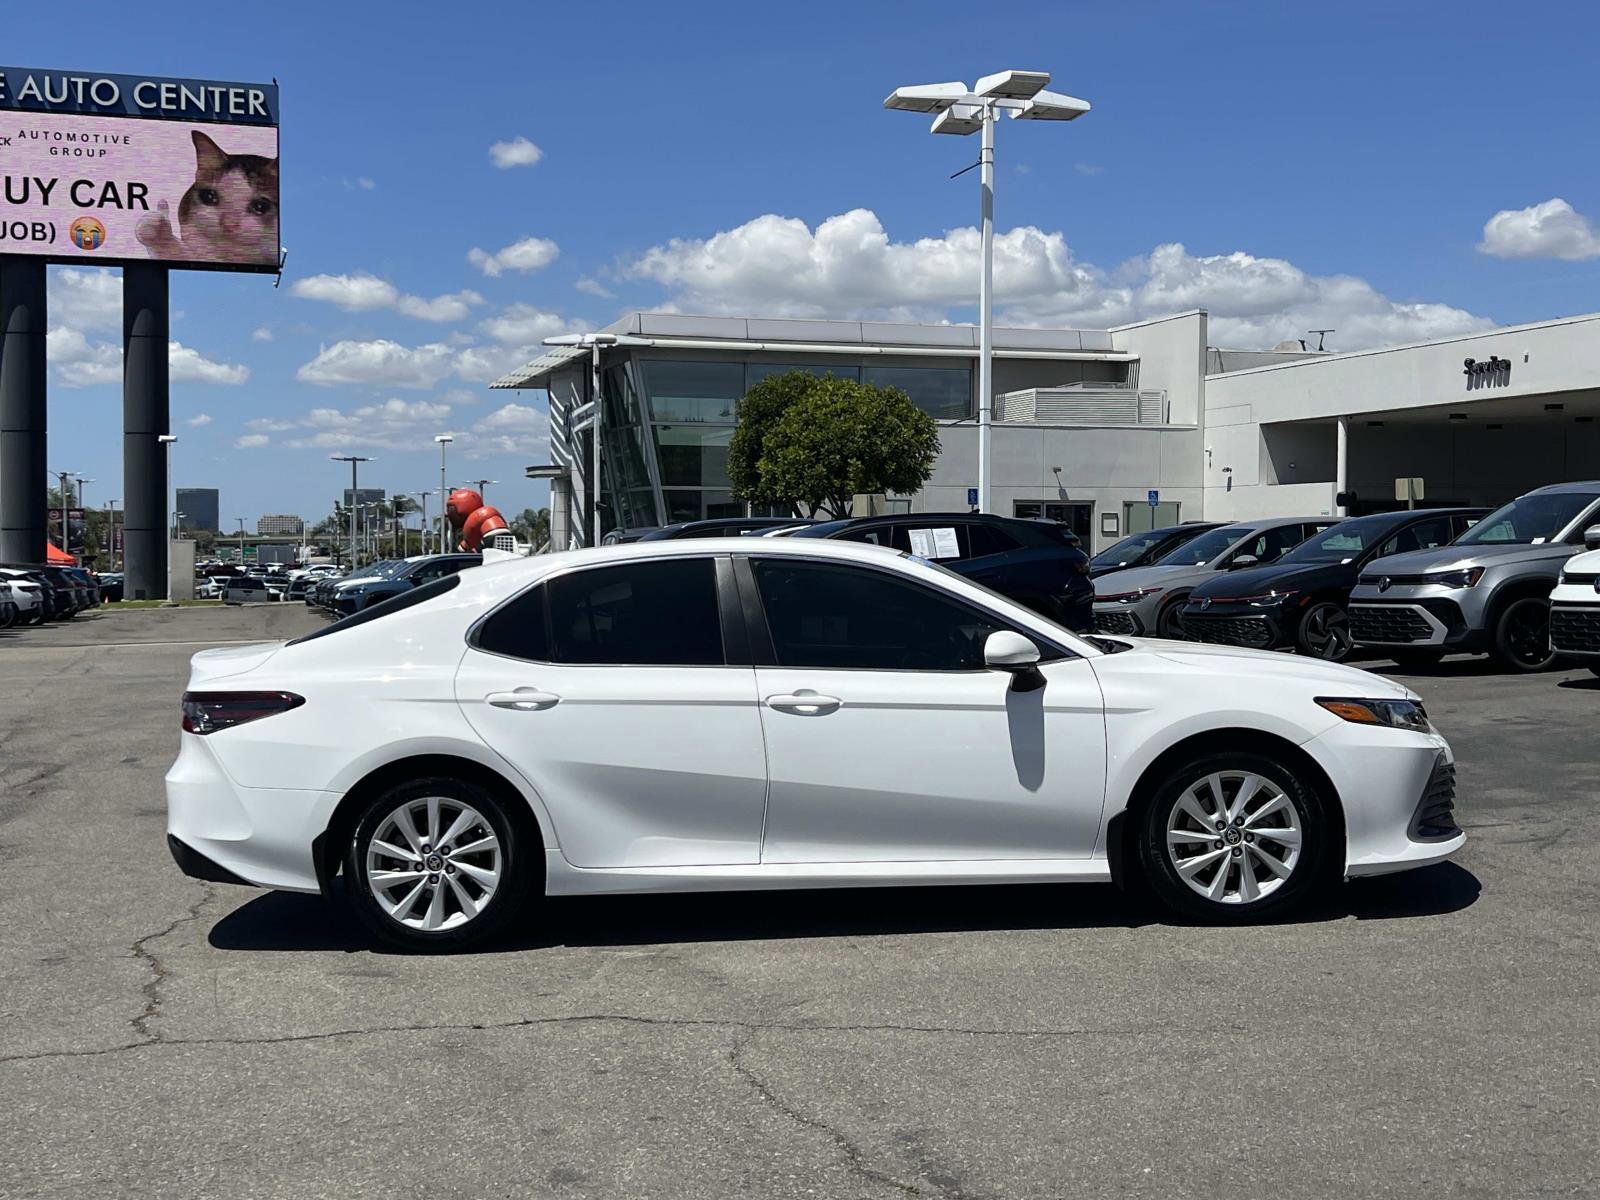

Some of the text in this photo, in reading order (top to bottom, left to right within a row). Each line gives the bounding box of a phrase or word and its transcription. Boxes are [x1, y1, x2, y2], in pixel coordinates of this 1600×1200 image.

[18, 75, 120, 106] AUTO
[134, 81, 267, 116] CENTER
[18, 129, 131, 145] AUTOMOTIVE
[50, 146, 107, 158] GROUP
[70, 179, 149, 211] CAR
